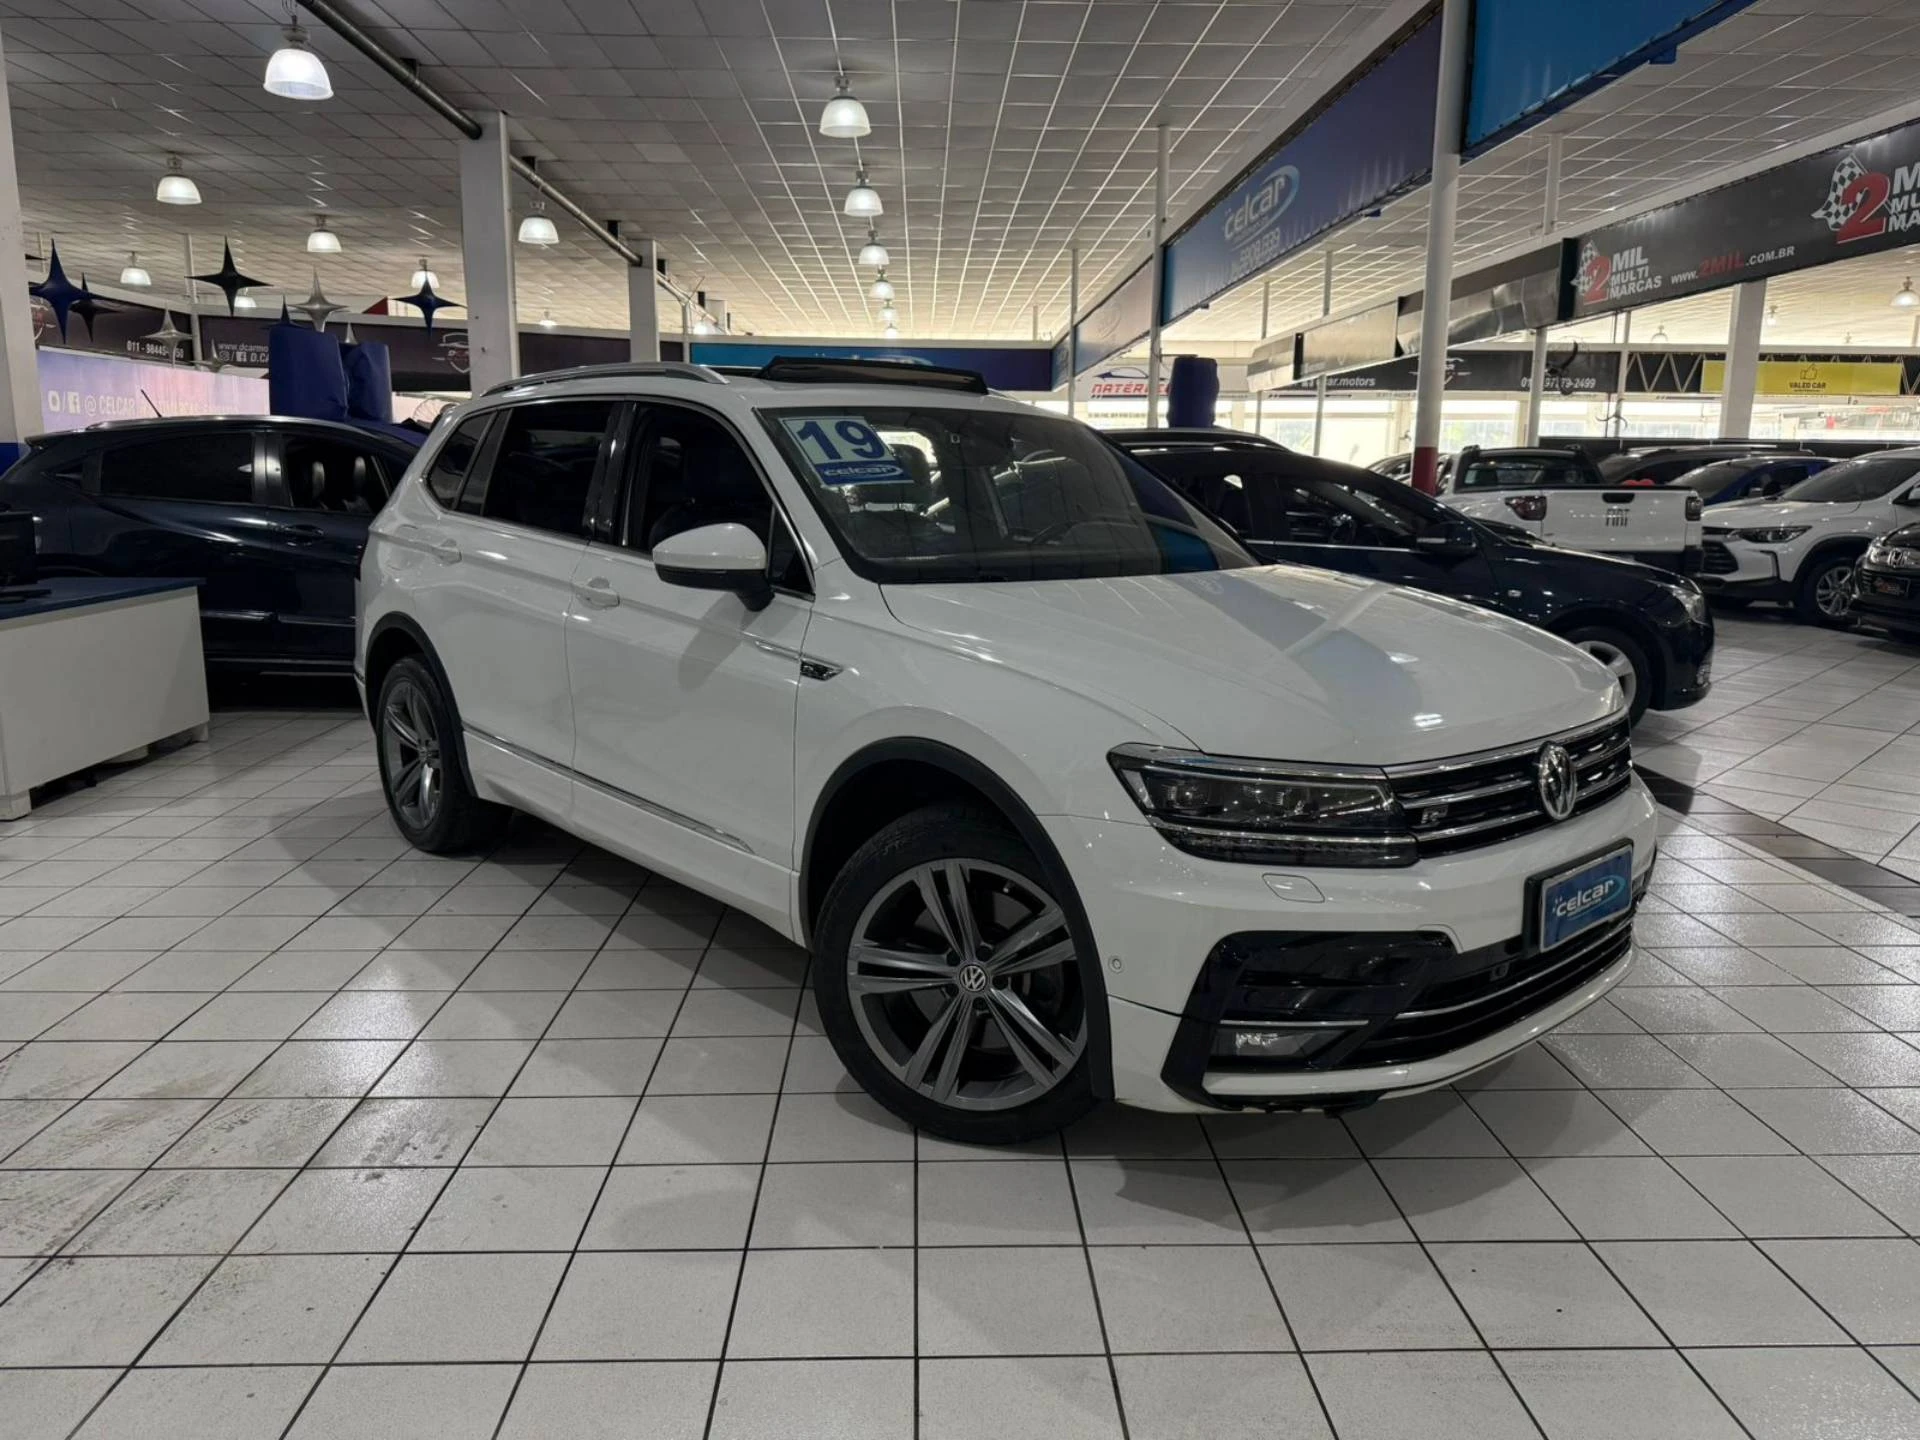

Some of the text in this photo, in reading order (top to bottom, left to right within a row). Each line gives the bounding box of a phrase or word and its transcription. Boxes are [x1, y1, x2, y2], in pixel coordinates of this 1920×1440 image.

[1612, 246, 1649, 272] MIL
[1609, 275, 1662, 299] MARCAS
[1611, 265, 1649, 287] MULTI
[796, 420, 885, 460] 19
[1556, 879, 1614, 917] celcar
